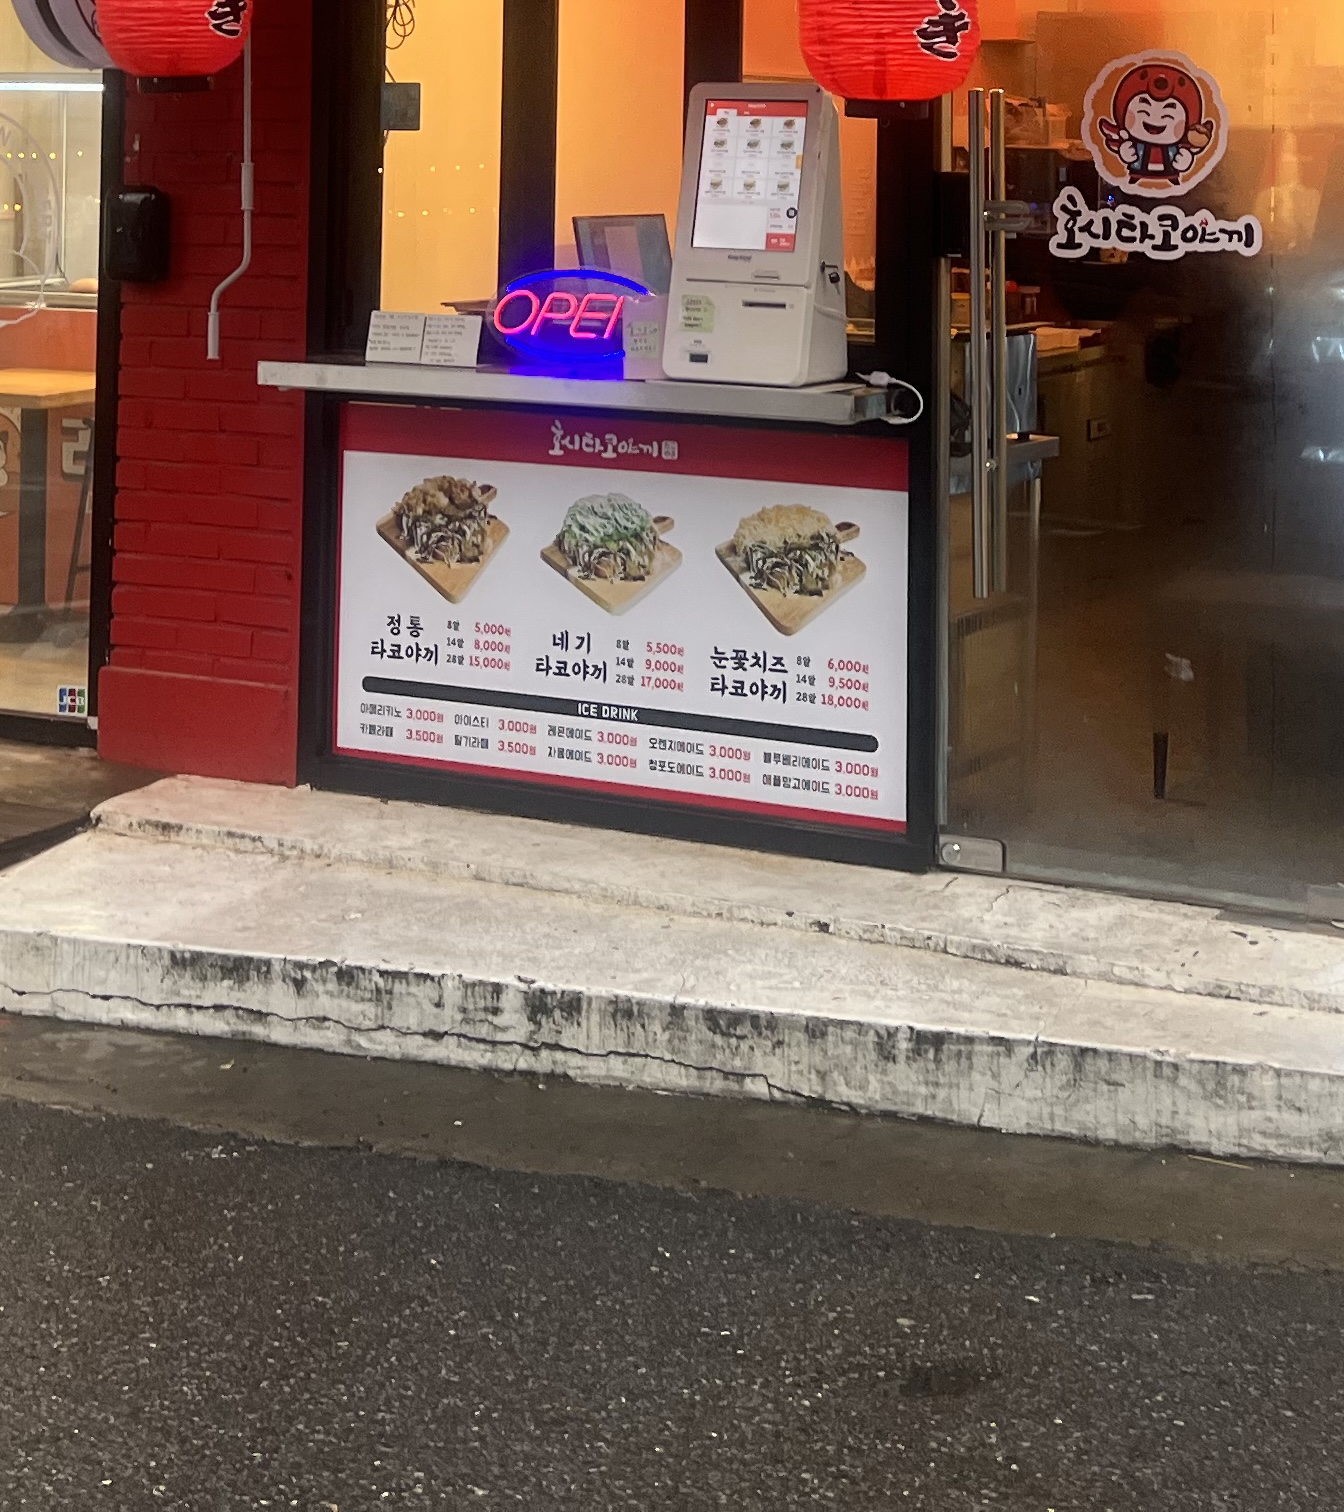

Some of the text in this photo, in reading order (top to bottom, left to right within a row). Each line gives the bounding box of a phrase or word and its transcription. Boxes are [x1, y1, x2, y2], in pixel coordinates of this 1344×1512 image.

[370, 638, 438, 667] 타코야끼
[710, 646, 789, 674] 눈꽃치즈
[535, 655, 607, 684] 타코야끼
[710, 674, 787, 704] 타코야끼
[577, 702, 639, 721] ICE DRINK
